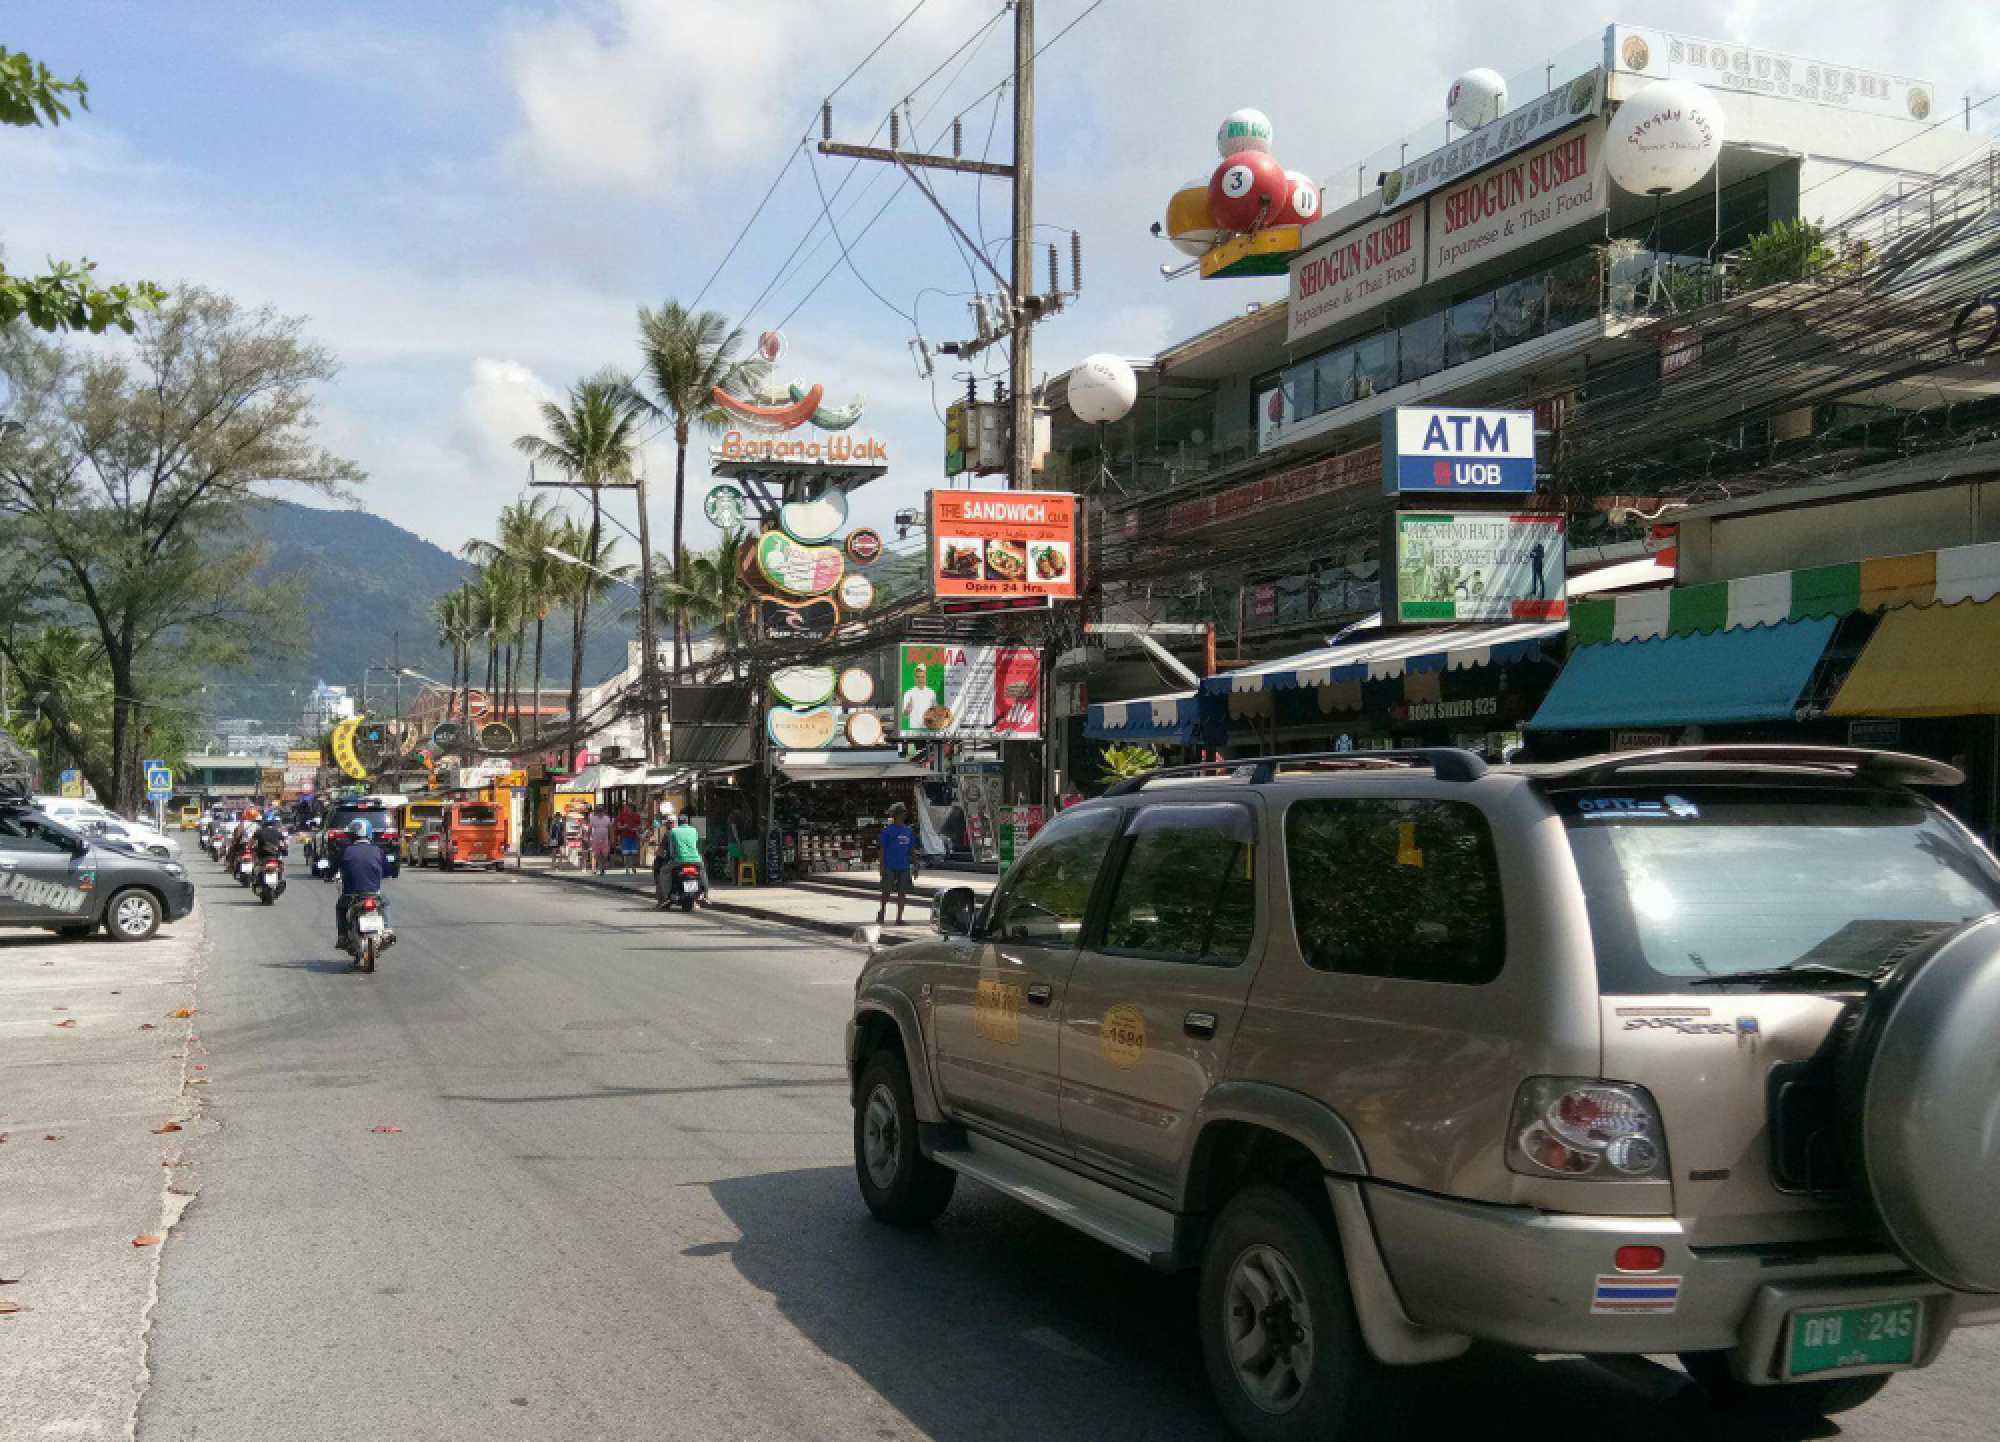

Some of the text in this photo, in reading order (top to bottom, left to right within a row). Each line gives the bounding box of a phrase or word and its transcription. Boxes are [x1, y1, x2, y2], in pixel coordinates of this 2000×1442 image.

[1670, 39, 1890, 100] SHOGUN SUSHI
[1231, 172, 1243, 190] 3
[1445, 163, 1524, 235] SHOGUN
[1530, 133, 1586, 199] SUSHI
[1302, 191, 1312, 210] 11
[1438, 182, 1593, 268] Japanese & Thai Food
[1300, 214, 1412, 300] SHOGUN SUSHI
[1294, 257, 1416, 330] Japanese & Thai Food
[723, 431, 888, 460] Banana Walk
[1422, 414, 1510, 453] ATM
[1455, 463, 1502, 485] UOB
[940, 501, 1069, 523] THE SANDWICH CLUB
[965, 582, 1047, 593] Open 24 Hrs.
[907, 647, 968, 666] ROMA
[1007, 702, 1035, 728] illy
[1408, 697, 1497, 721] ROCK SILVER 925
[1110, 1027, 1142, 1050] 1584
